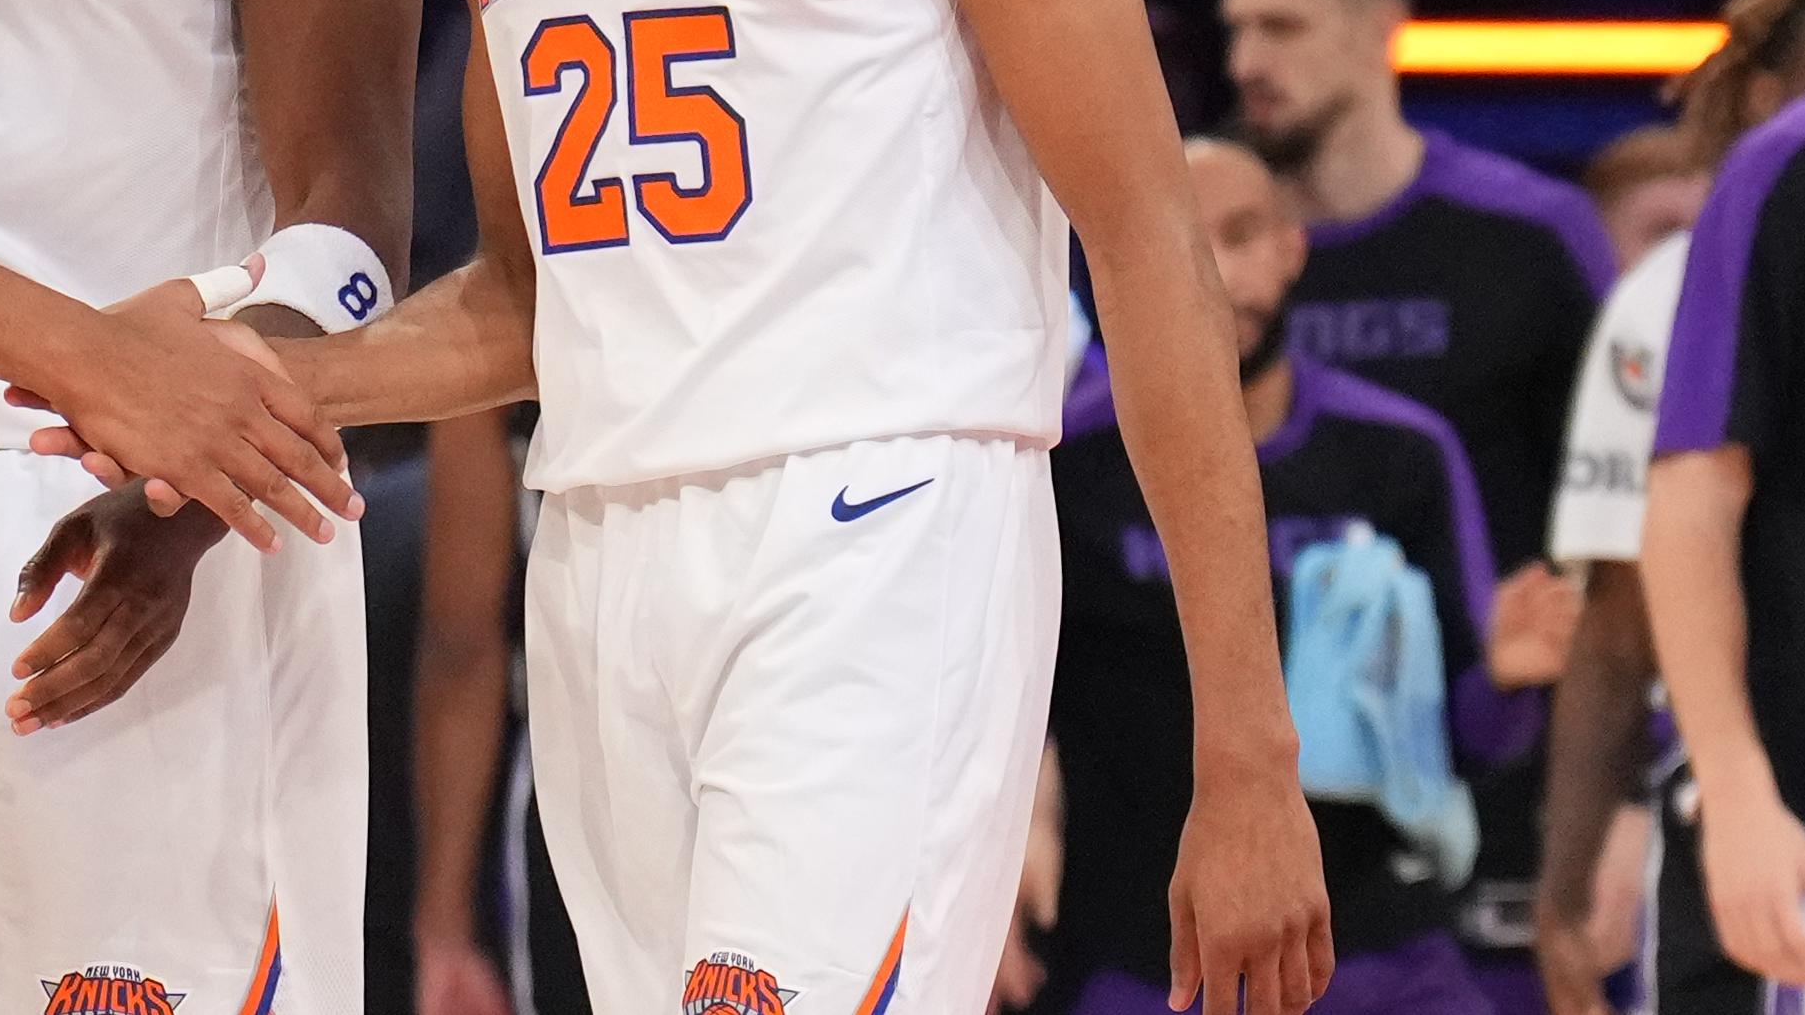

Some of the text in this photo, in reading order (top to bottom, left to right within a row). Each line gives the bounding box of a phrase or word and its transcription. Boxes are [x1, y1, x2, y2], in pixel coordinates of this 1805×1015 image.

[521, 6, 753, 255] 25
[338, 272, 378, 320] 8
[1288, 300, 1450, 358] NGS
[85, 966, 142, 982] NEW YORK
[709, 951, 755, 971] NEW YORK
[44, 971, 175, 1015] KNICKS
[682, 958, 786, 1015] KNICKS
